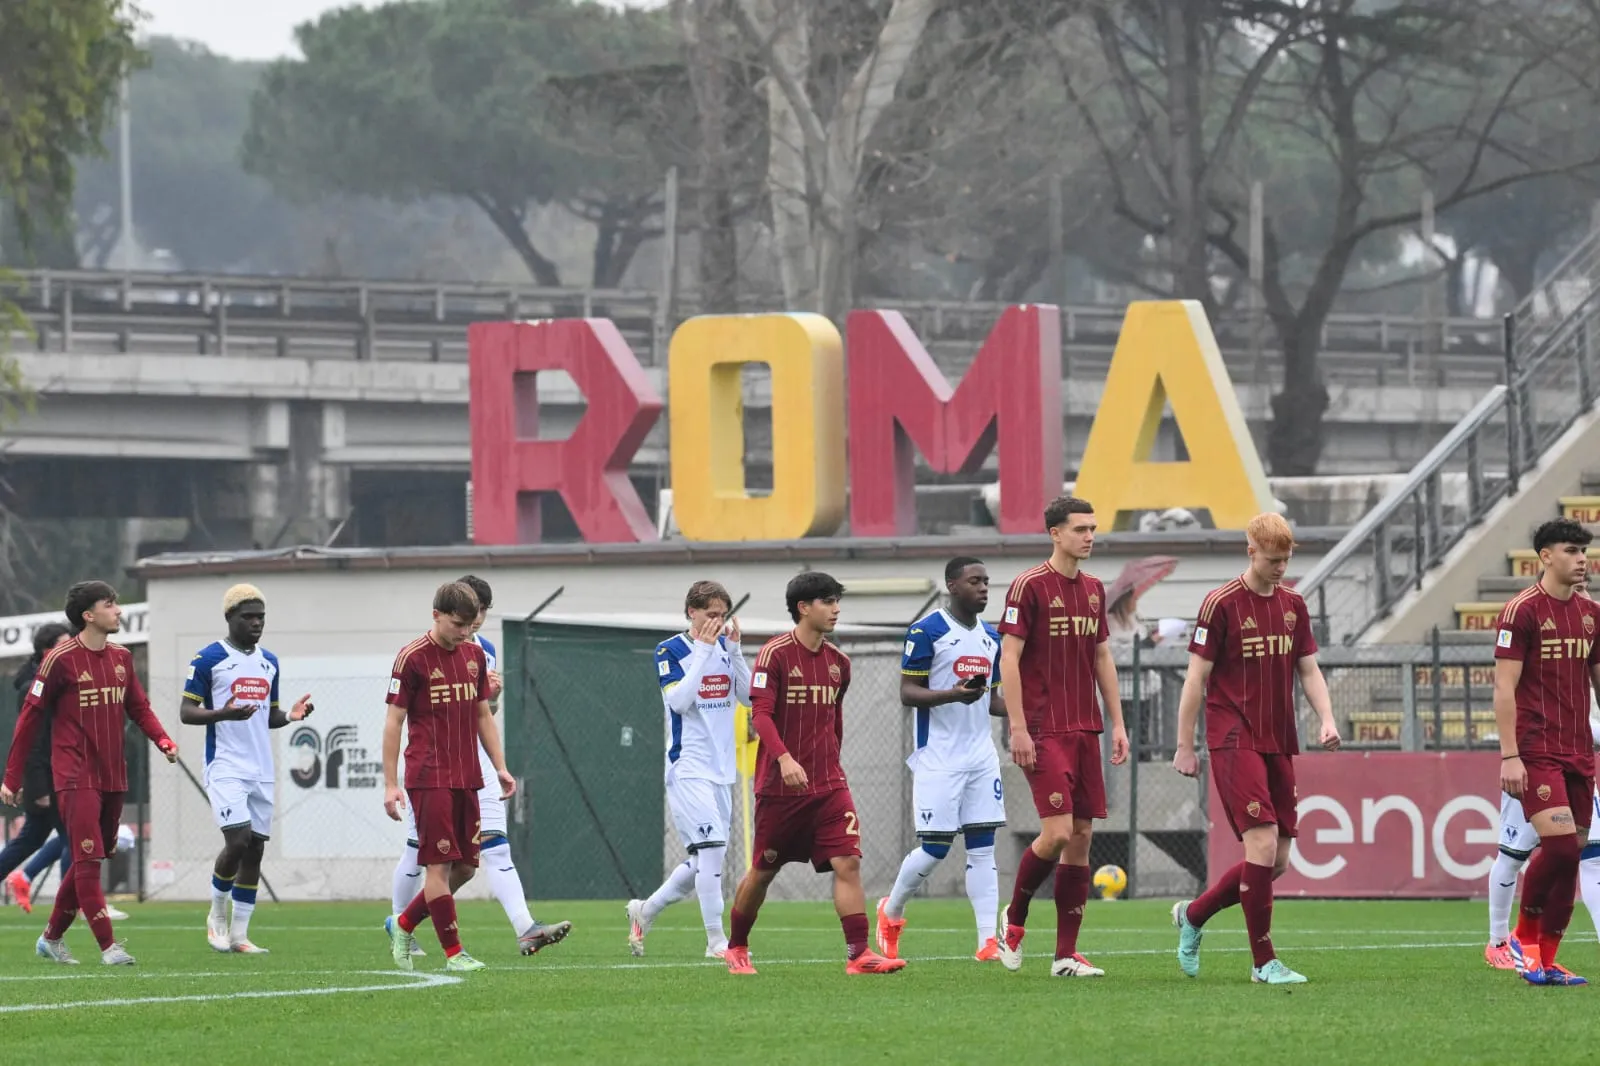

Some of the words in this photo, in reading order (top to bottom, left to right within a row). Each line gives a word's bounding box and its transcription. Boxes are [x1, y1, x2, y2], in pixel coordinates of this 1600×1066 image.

[467, 298, 1275, 545] ROMA
[1071, 616, 1099, 637] TIM
[1266, 635, 1294, 655] TIM
[1563, 638, 1594, 659] TIM
[957, 662, 989, 674] Bonomi
[100, 686, 127, 705] TIM
[452, 682, 478, 702] TIM
[699, 682, 731, 692] Bonomi
[809, 685, 841, 705] TIM
[1359, 725, 1394, 741] FILA
[993, 778, 1002, 801] 9
[844, 811, 860, 837] 2
[1289, 794, 1500, 881] ene
